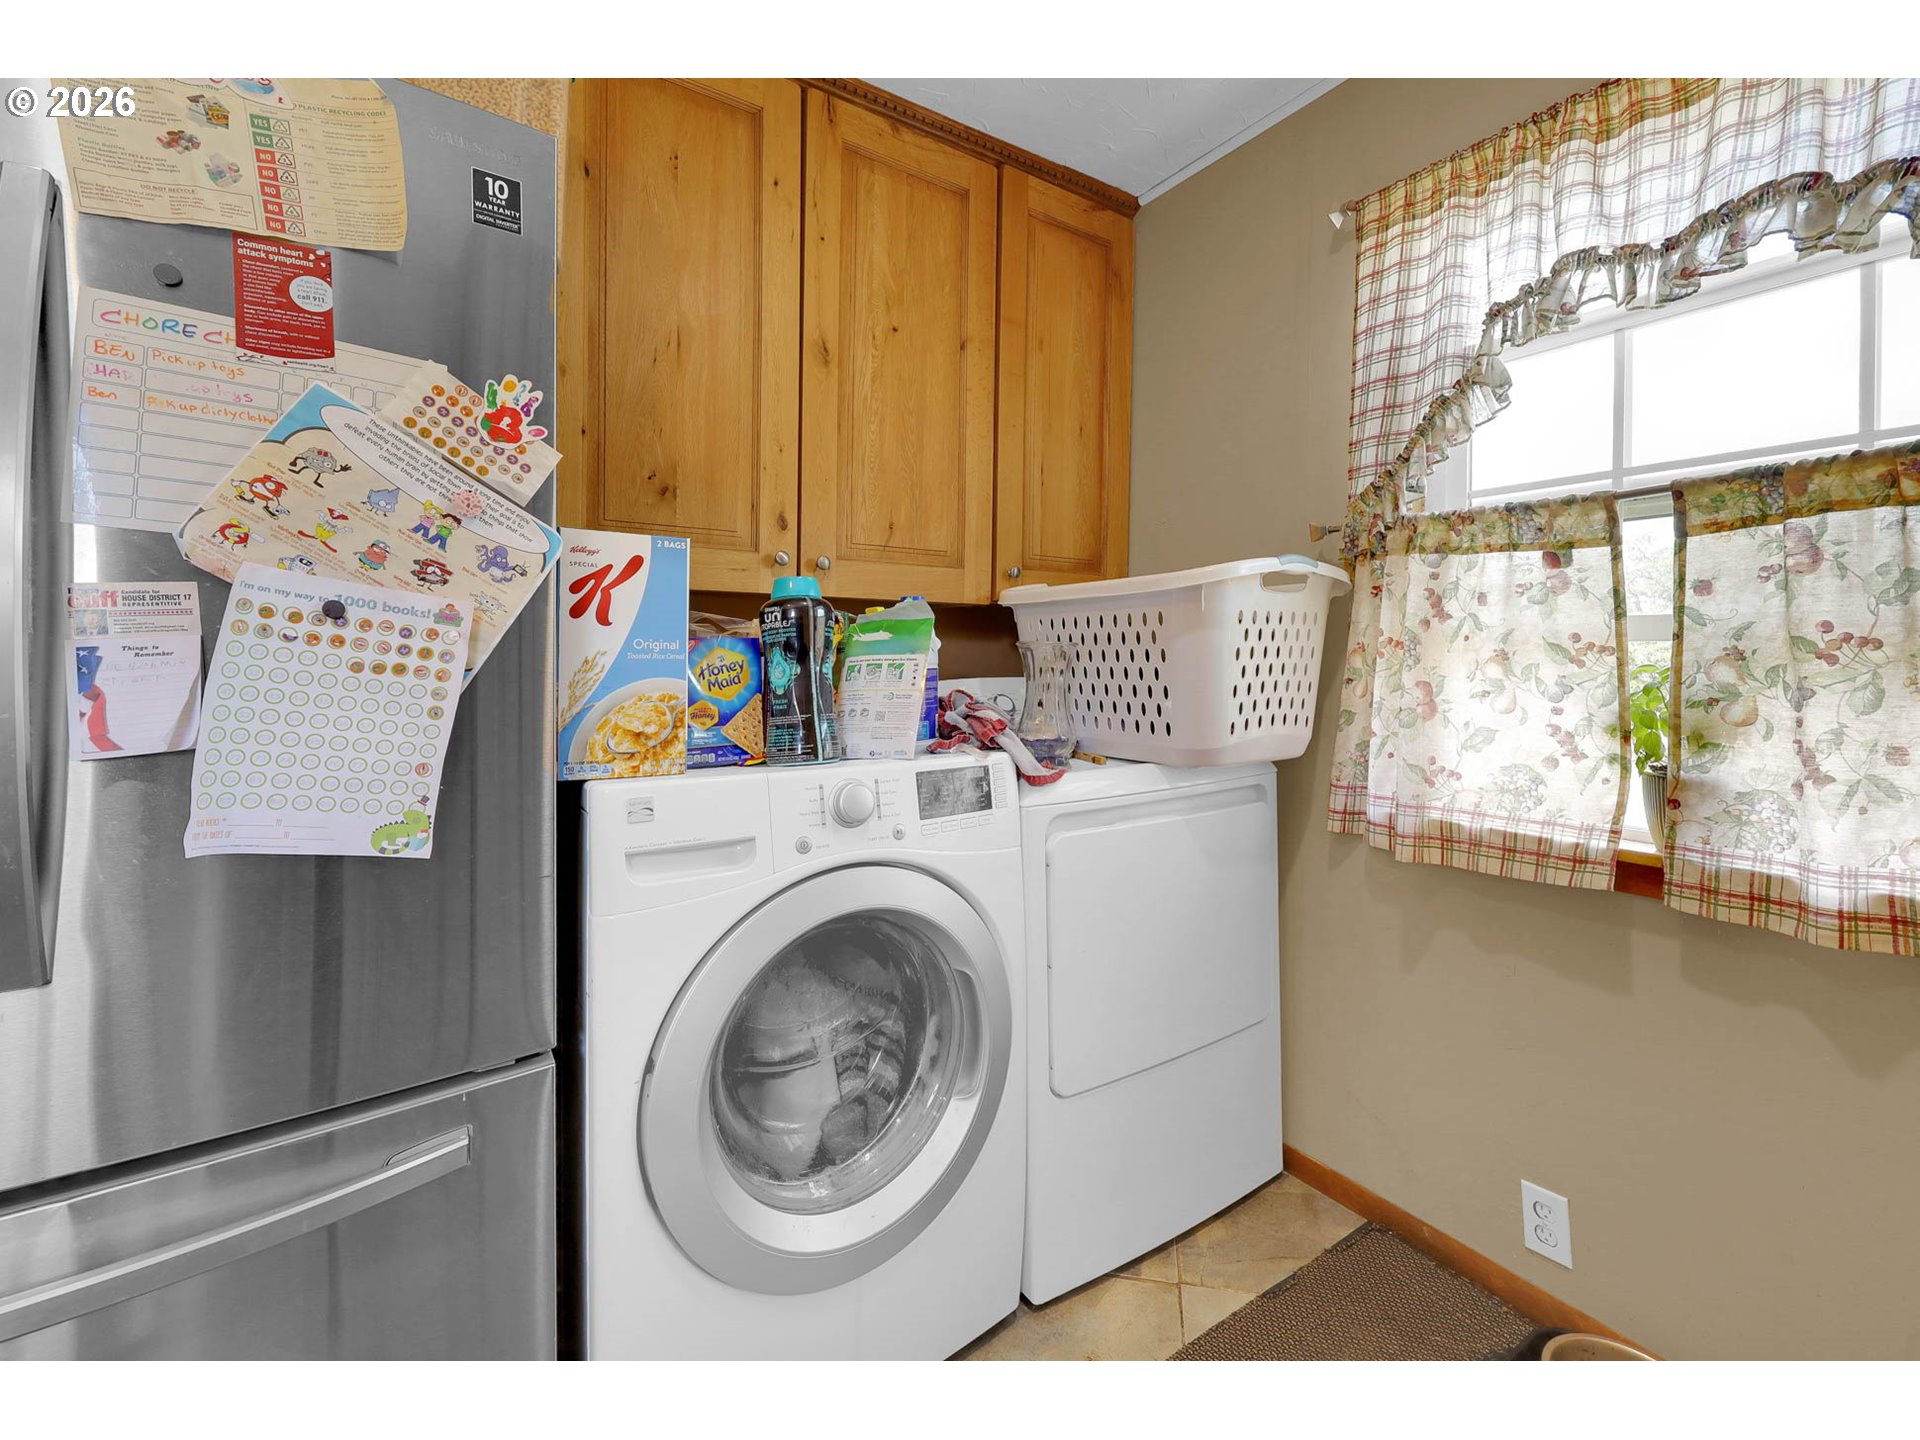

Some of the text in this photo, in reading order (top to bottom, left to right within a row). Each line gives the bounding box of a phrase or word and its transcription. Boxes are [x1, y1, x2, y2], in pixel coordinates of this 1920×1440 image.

[298, 104, 328, 113] PLASTIC
[328, 108, 365, 116] RECYCLING
[252, 117, 268, 126] YES
[256, 135, 270, 144] YES
[264, 186, 276, 194] NO
[485, 177, 509, 200] 10
[267, 204, 278, 212] NO
[474, 200, 520, 218] WARRANTY
[488, 196, 506, 206] YEAR
[270, 221, 281, 229] NO
[476, 213, 496, 223] DIGITAL
[237, 238, 303, 257] Common heart
[238, 247, 314, 267] attack symptoms
[312, 296, 327, 304] 911.
[100, 309, 198, 338] CHORE
[93, 339, 246, 380] BEN Pick up toys
[87, 385, 117, 400] Ben
[179, 404, 197, 416] up
[201, 403, 238, 422] dirty
[364, 426, 390, 445] invading
[390, 440, 401, 452] the
[401, 448, 420, 463] brains
[429, 464, 447, 480] Social
[485, 502, 500, 515] Their
[500, 510, 514, 523] goal
[368, 418, 387, 432] These
[387, 428, 424, 458] Unthinkables
[424, 454, 438, 465] have
[439, 462, 454, 475] been
[454, 473, 474, 489] around
[479, 488, 492, 502] long
[492, 497, 505, 509] time
[504, 504, 518, 517] and
[515, 510, 531, 525] enjoy
[344, 422, 366, 439] defeat
[366, 436, 385, 451] every
[386, 446, 406, 462] human
[406, 458, 422, 472] brain
[429, 474, 451, 494] getting
[490, 512, 508, 529] things
[506, 524, 519, 535] that
[518, 530, 533, 543] show
[378, 453, 400, 468] others
[401, 466, 416, 481] they
[416, 475, 427, 486] are
[426, 482, 438, 493] not
[477, 517, 494, 529] them
[570, 545, 600, 556] Kellogg's
[240, 580, 255, 590] I'm
[275, 588, 291, 600] my
[294, 592, 316, 603] way
[334, 594, 377, 610] 1000
[382, 601, 432, 619] books!
[569, 554, 644, 626] K
[633, 638, 679, 652] Original
[698, 660, 744, 680] Honey
[707, 672, 742, 692] Maid
[690, 712, 715, 721] Honey
